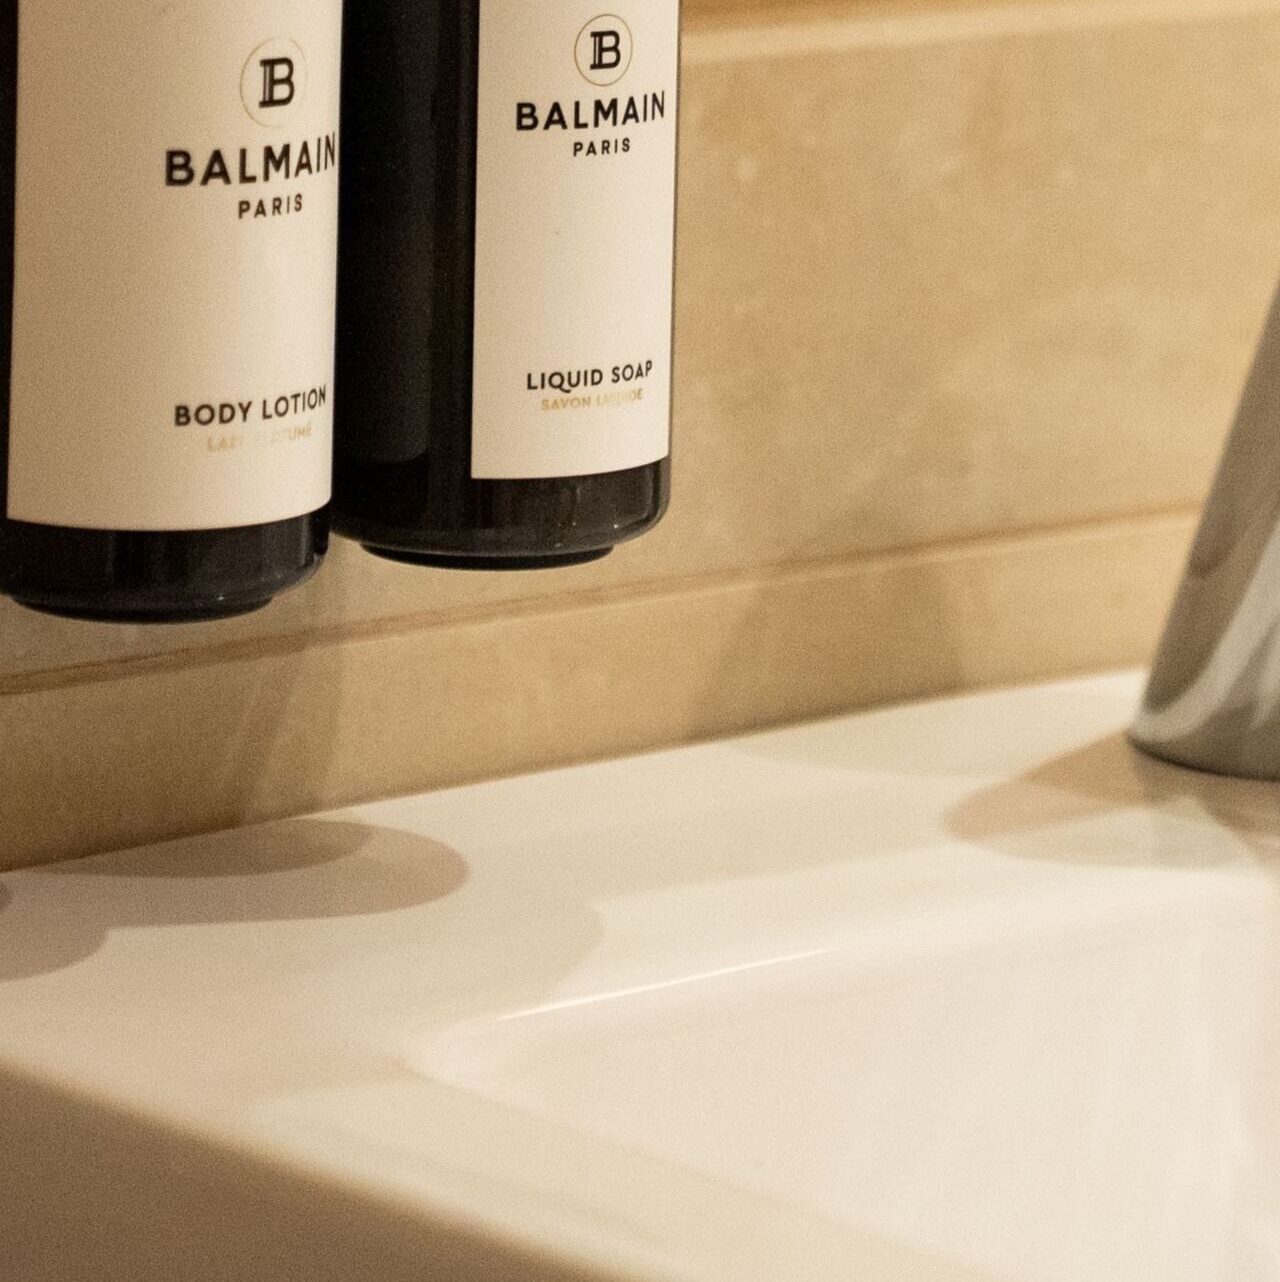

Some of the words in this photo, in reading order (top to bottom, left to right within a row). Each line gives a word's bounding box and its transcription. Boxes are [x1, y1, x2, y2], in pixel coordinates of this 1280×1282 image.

[590, 30, 621, 70] B
[258, 57, 295, 109] B
[516, 90, 665, 131] BALMAIN
[165, 130, 336, 186] BALMAIN
[573, 137, 631, 157] PARIS
[238, 193, 303, 220] PARIS
[527, 369, 603, 393] LIQUID
[611, 360, 653, 384] SOAP
[175, 401, 252, 427] BODY
[262, 384, 327, 420] LOTION
[541, 396, 592, 412] SAVON
